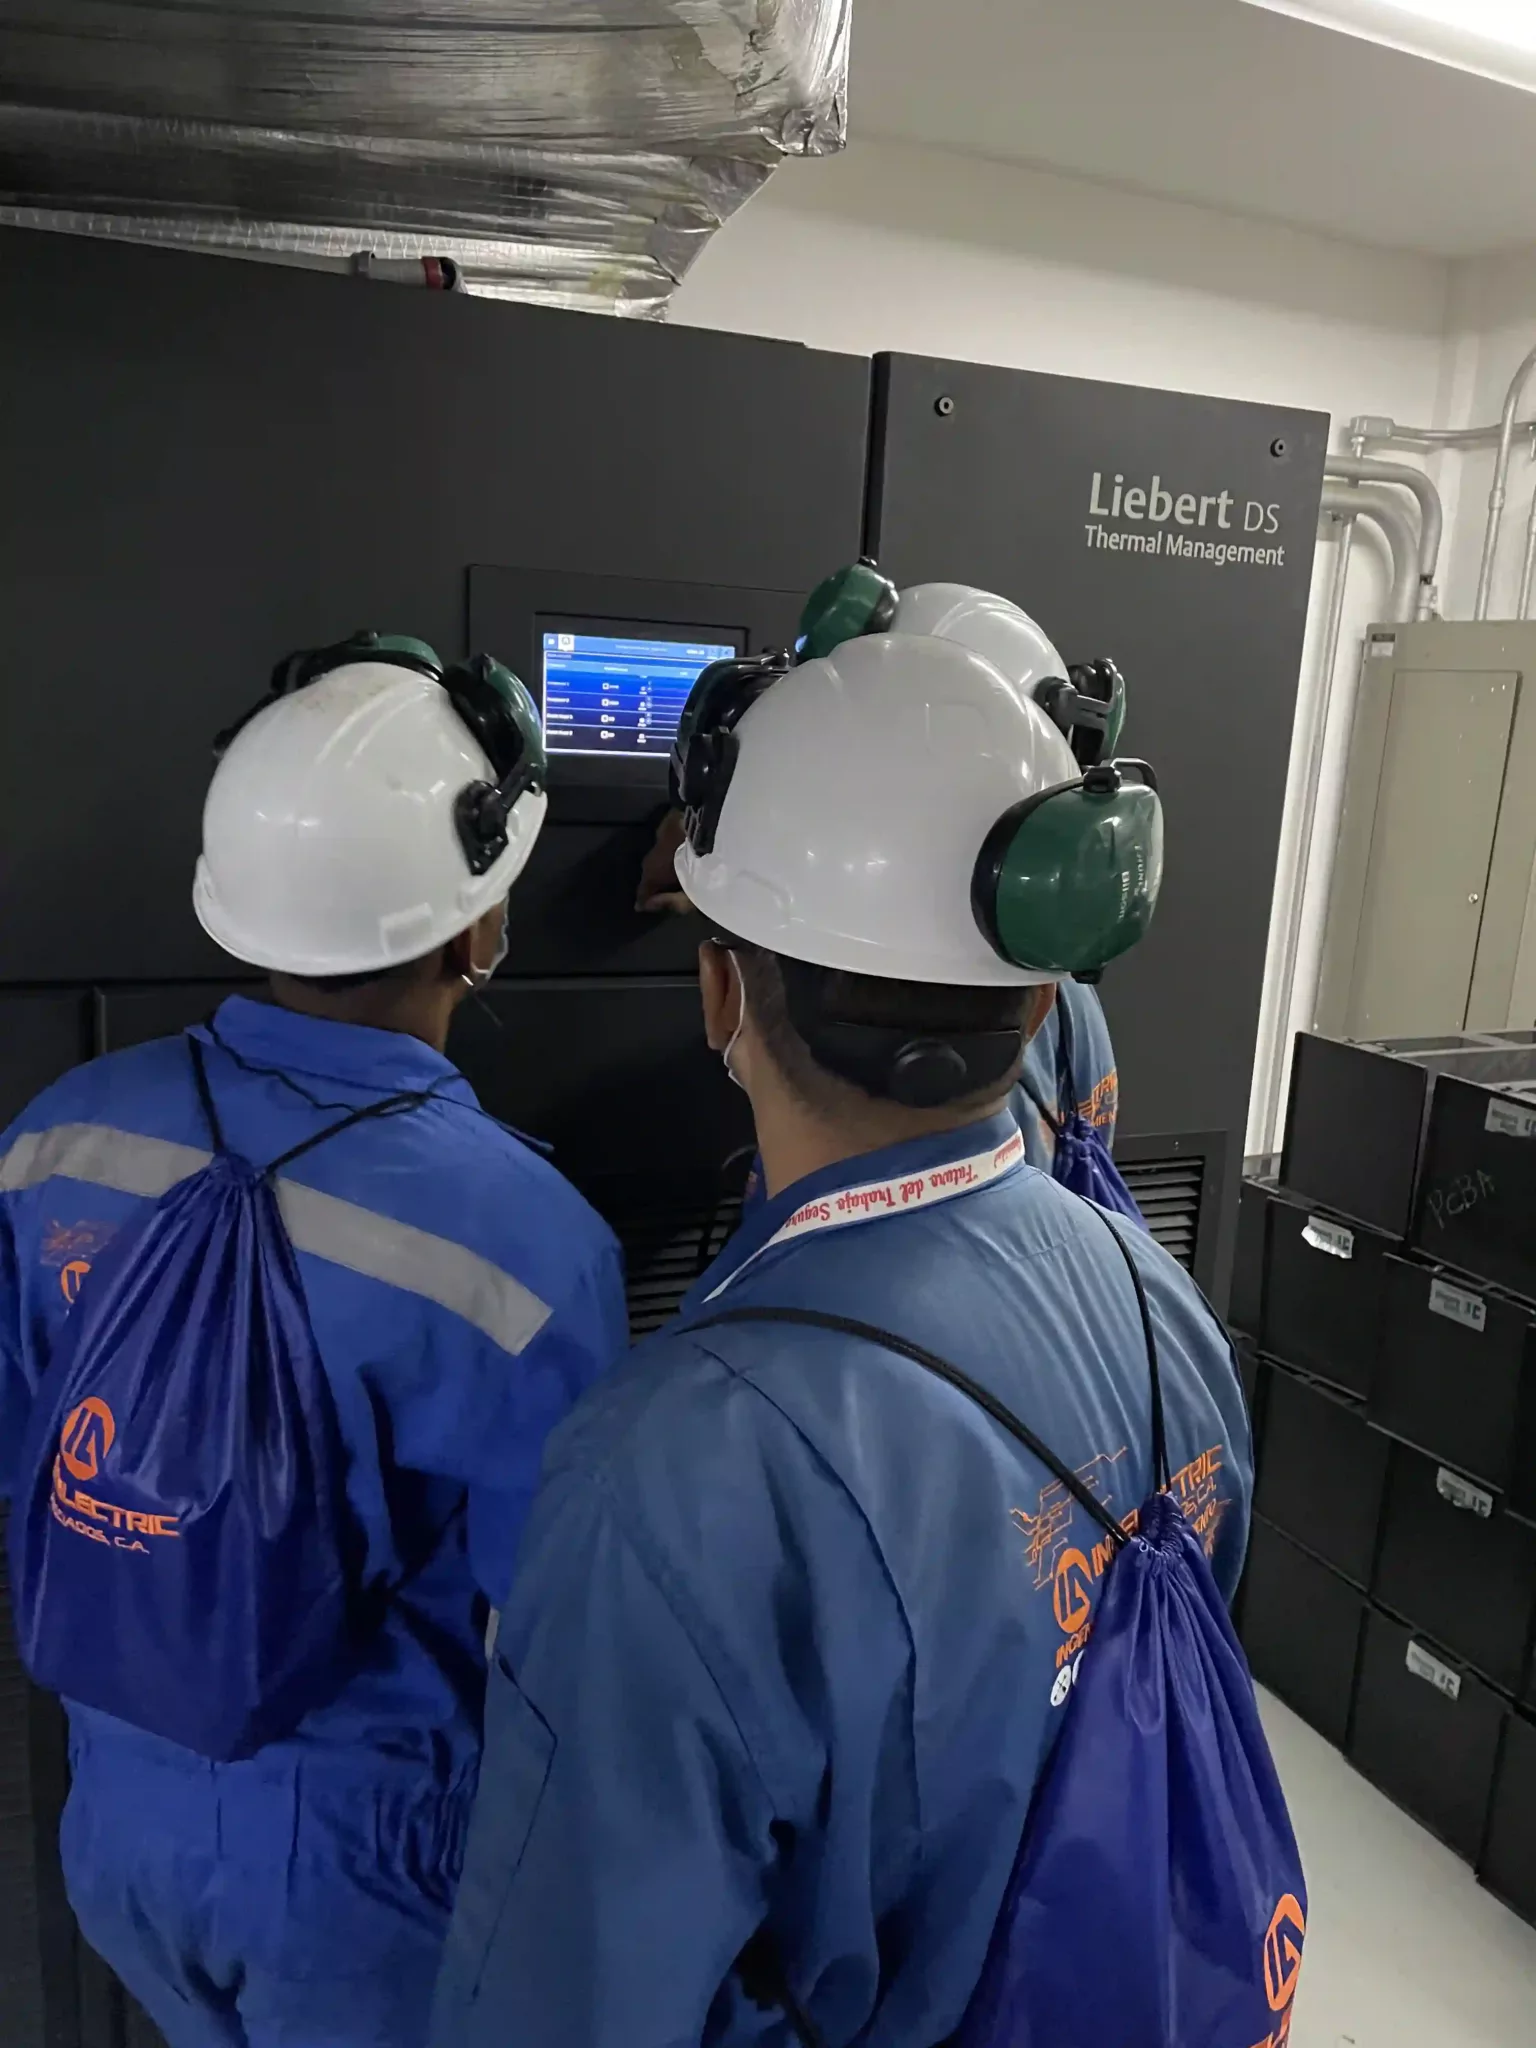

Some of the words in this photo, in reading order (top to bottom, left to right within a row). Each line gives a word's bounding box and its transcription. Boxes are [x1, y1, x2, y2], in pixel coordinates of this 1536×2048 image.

[1089, 472, 1234, 529] Liebert
[1244, 501, 1280, 534] DS
[1084, 524, 1162, 554] Thermal
[1166, 533, 1285, 566] Management
[836, 1187, 896, 1211] Trabajo
[900, 1179, 924, 1203] del
